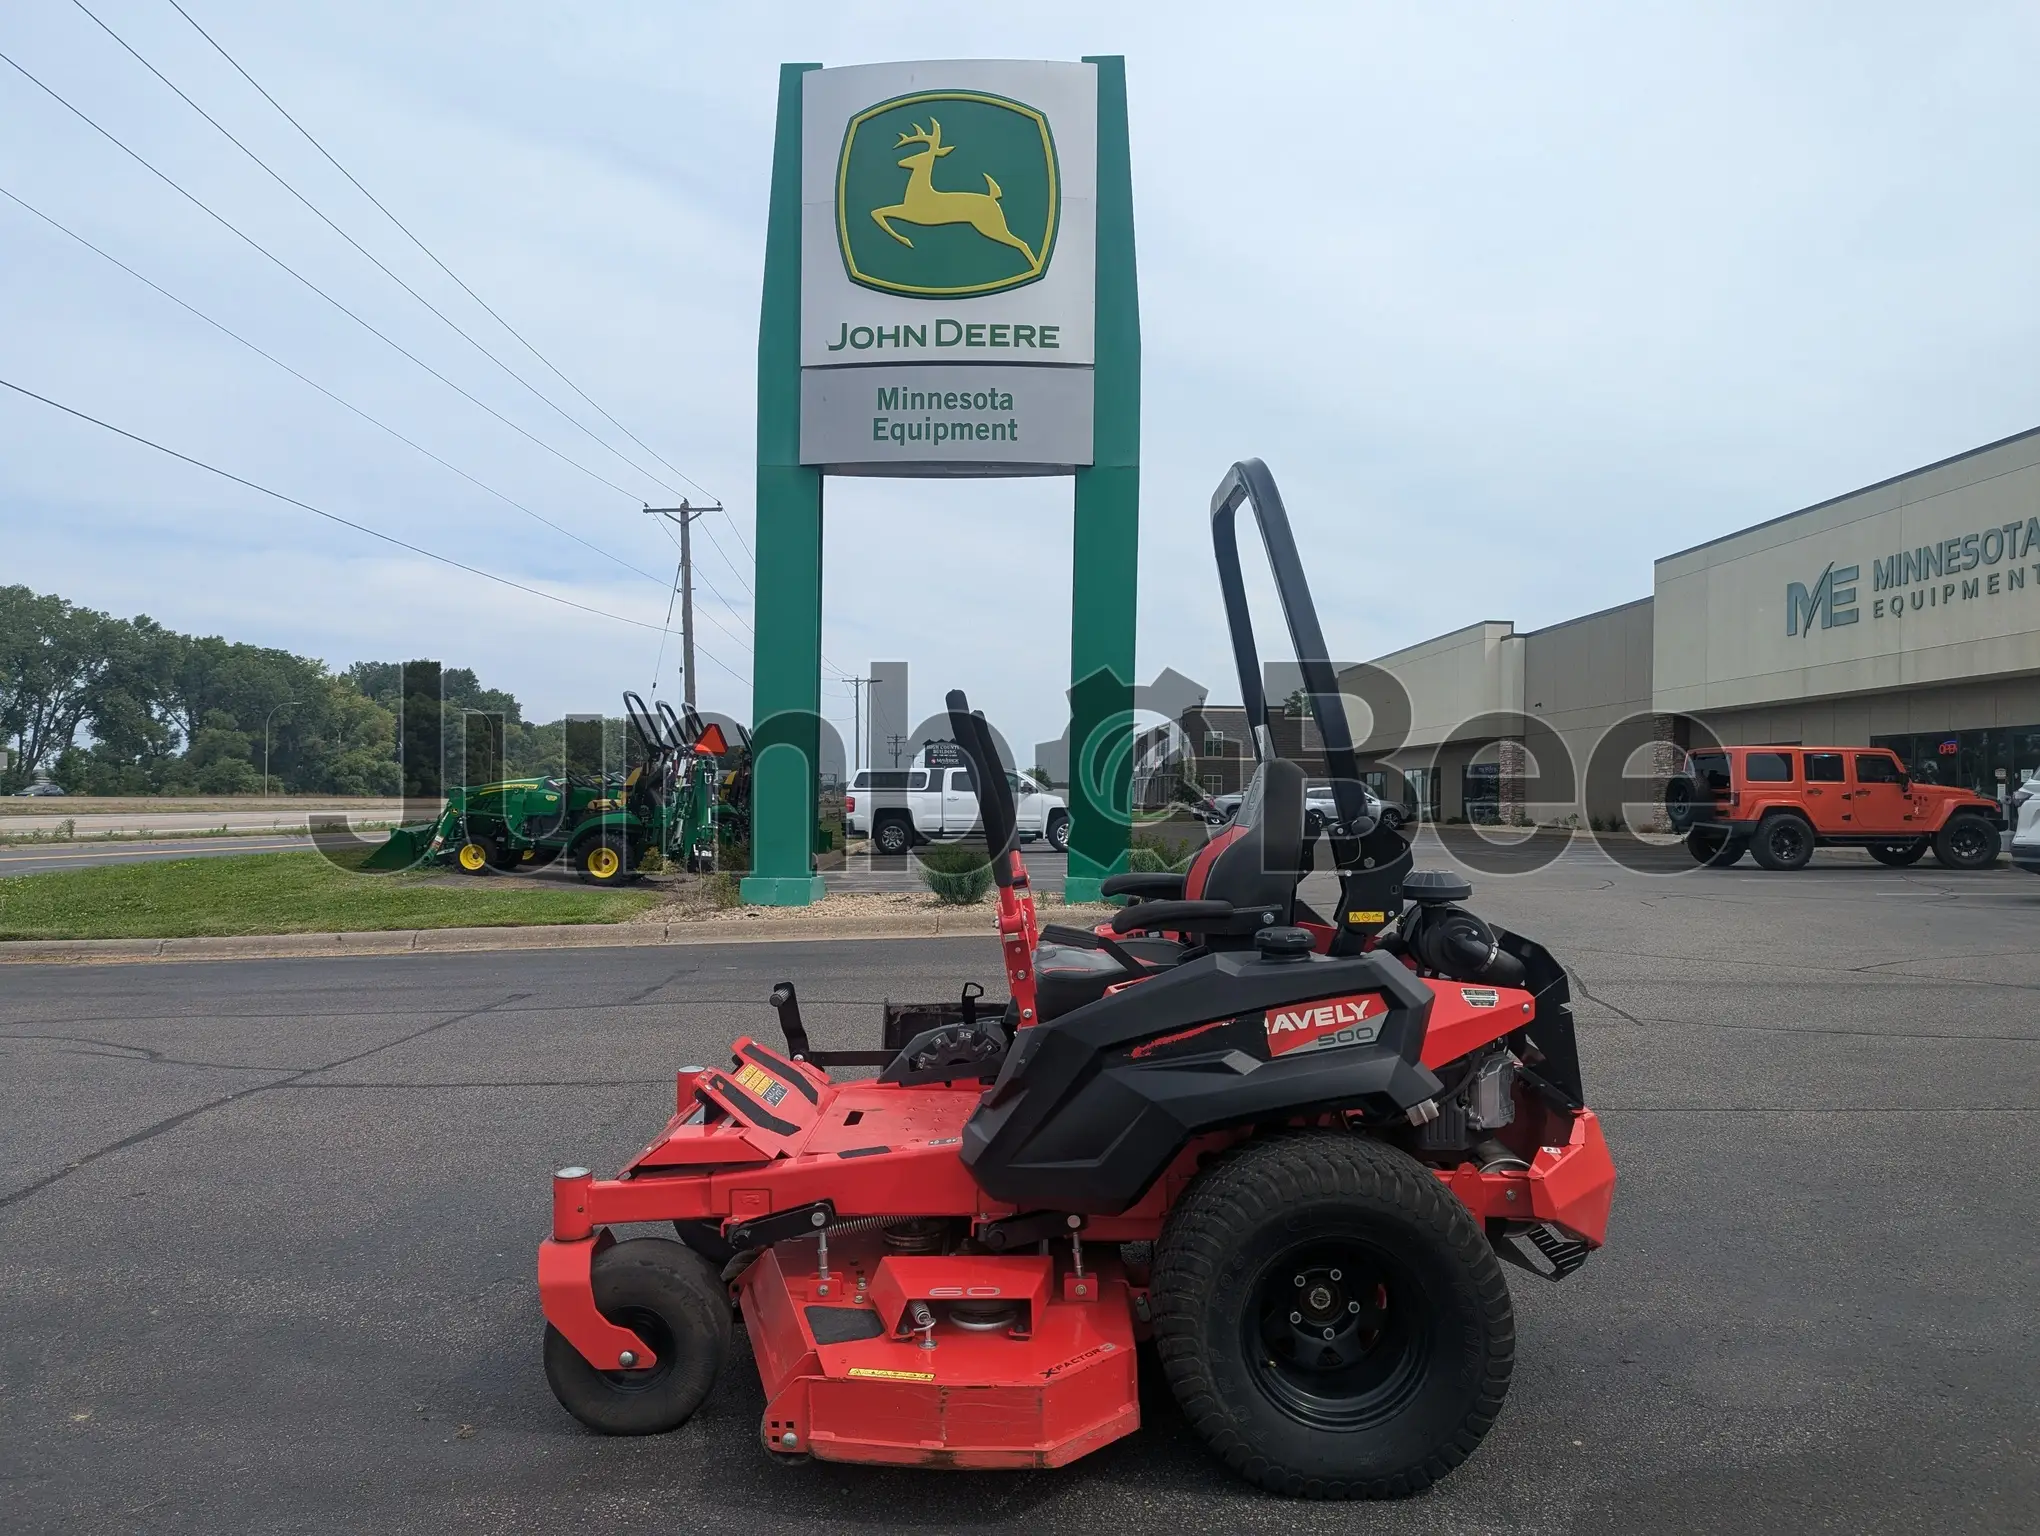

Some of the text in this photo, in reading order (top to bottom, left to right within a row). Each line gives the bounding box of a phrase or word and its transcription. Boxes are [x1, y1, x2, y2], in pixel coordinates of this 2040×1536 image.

[828, 318, 1060, 351] JOHN DEERE
[877, 386, 1014, 411] Minnesota
[873, 416, 1018, 446] Equipment
[1873, 517, 2040, 592] MINNESOTA
[1264, 999, 1370, 1035] AVELY
[1317, 1027, 1374, 1047] 500
[928, 1286, 1001, 1297] 60
